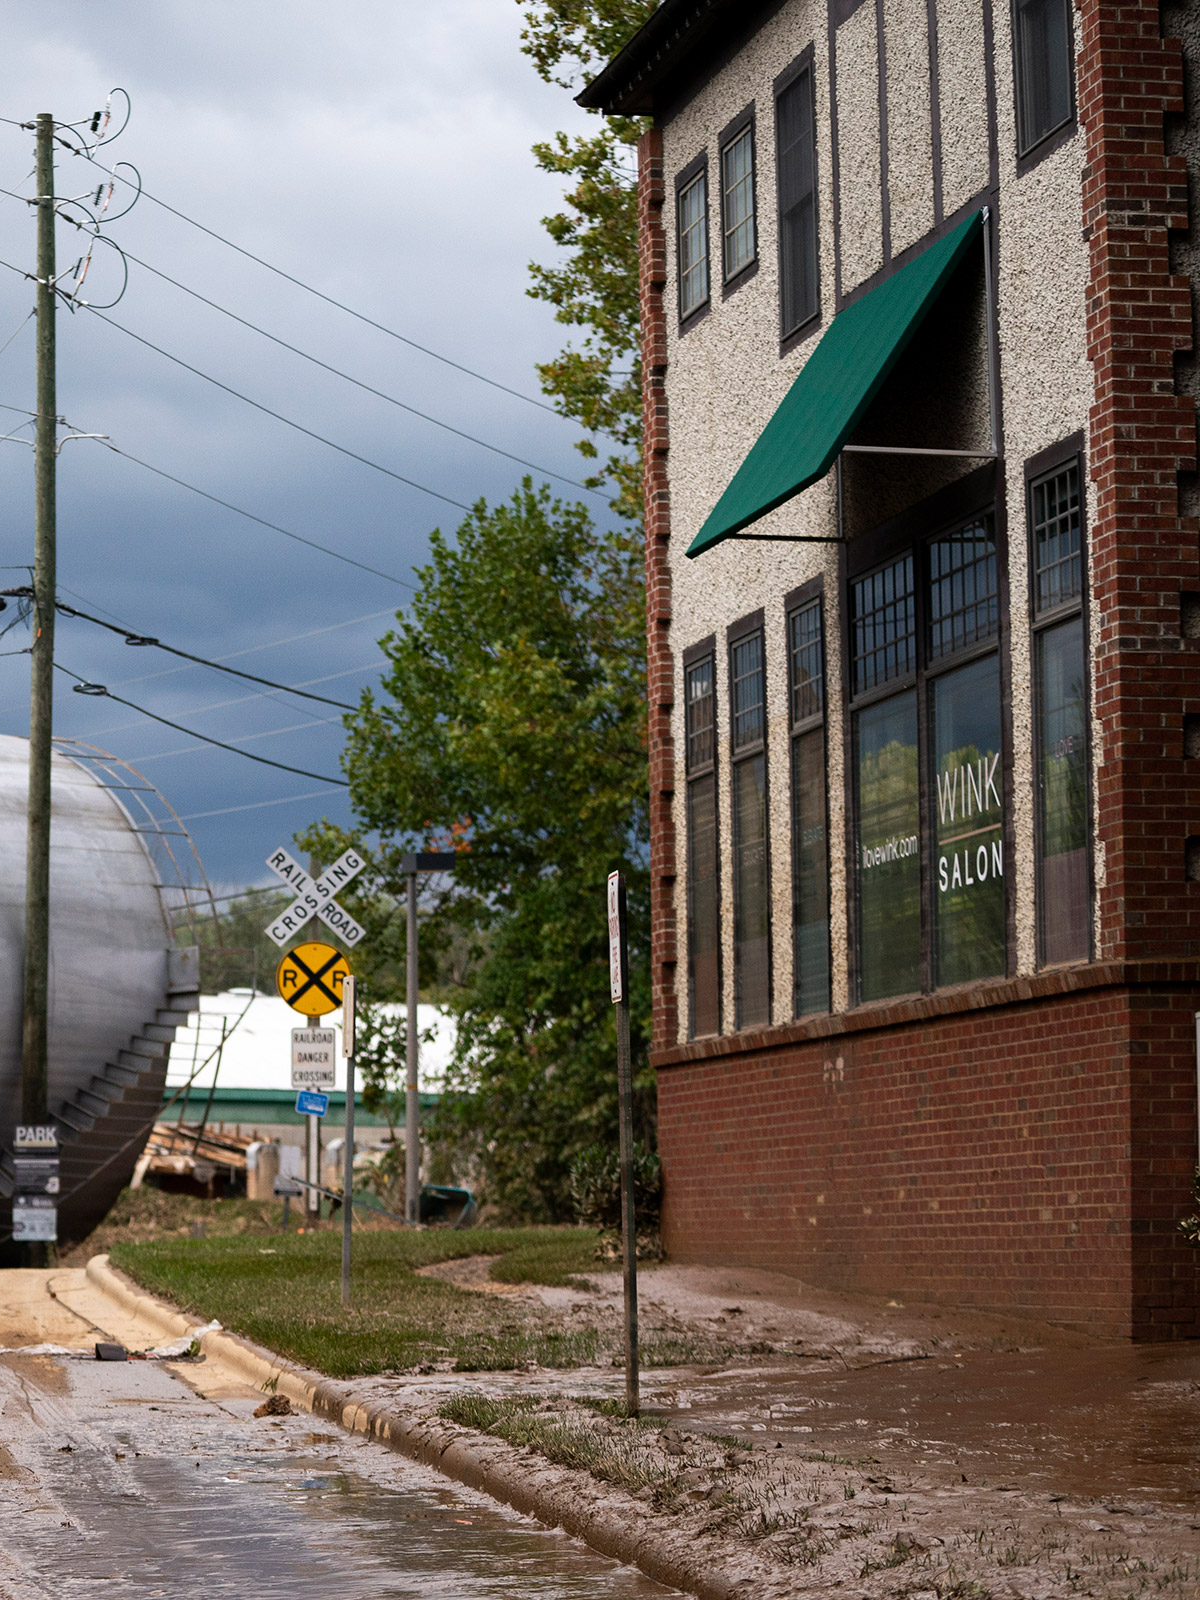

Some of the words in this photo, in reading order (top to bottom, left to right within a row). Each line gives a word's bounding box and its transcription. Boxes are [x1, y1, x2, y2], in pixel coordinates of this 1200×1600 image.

[937, 752, 1001, 825] WINK
[862, 835, 918, 869] ilovewink.com
[939, 840, 1003, 892] SALON
[271, 852, 304, 893] RAIL
[321, 902, 359, 941] ROAD
[272, 854, 359, 941] CROSSING
[283, 969, 297, 988] R
[332, 970, 344, 988] R
[293, 1033, 333, 1044] RAILROAD
[297, 1052, 329, 1063] DANGER
[293, 1072, 334, 1083] CROSSING
[16, 1126, 57, 1142] PARK
